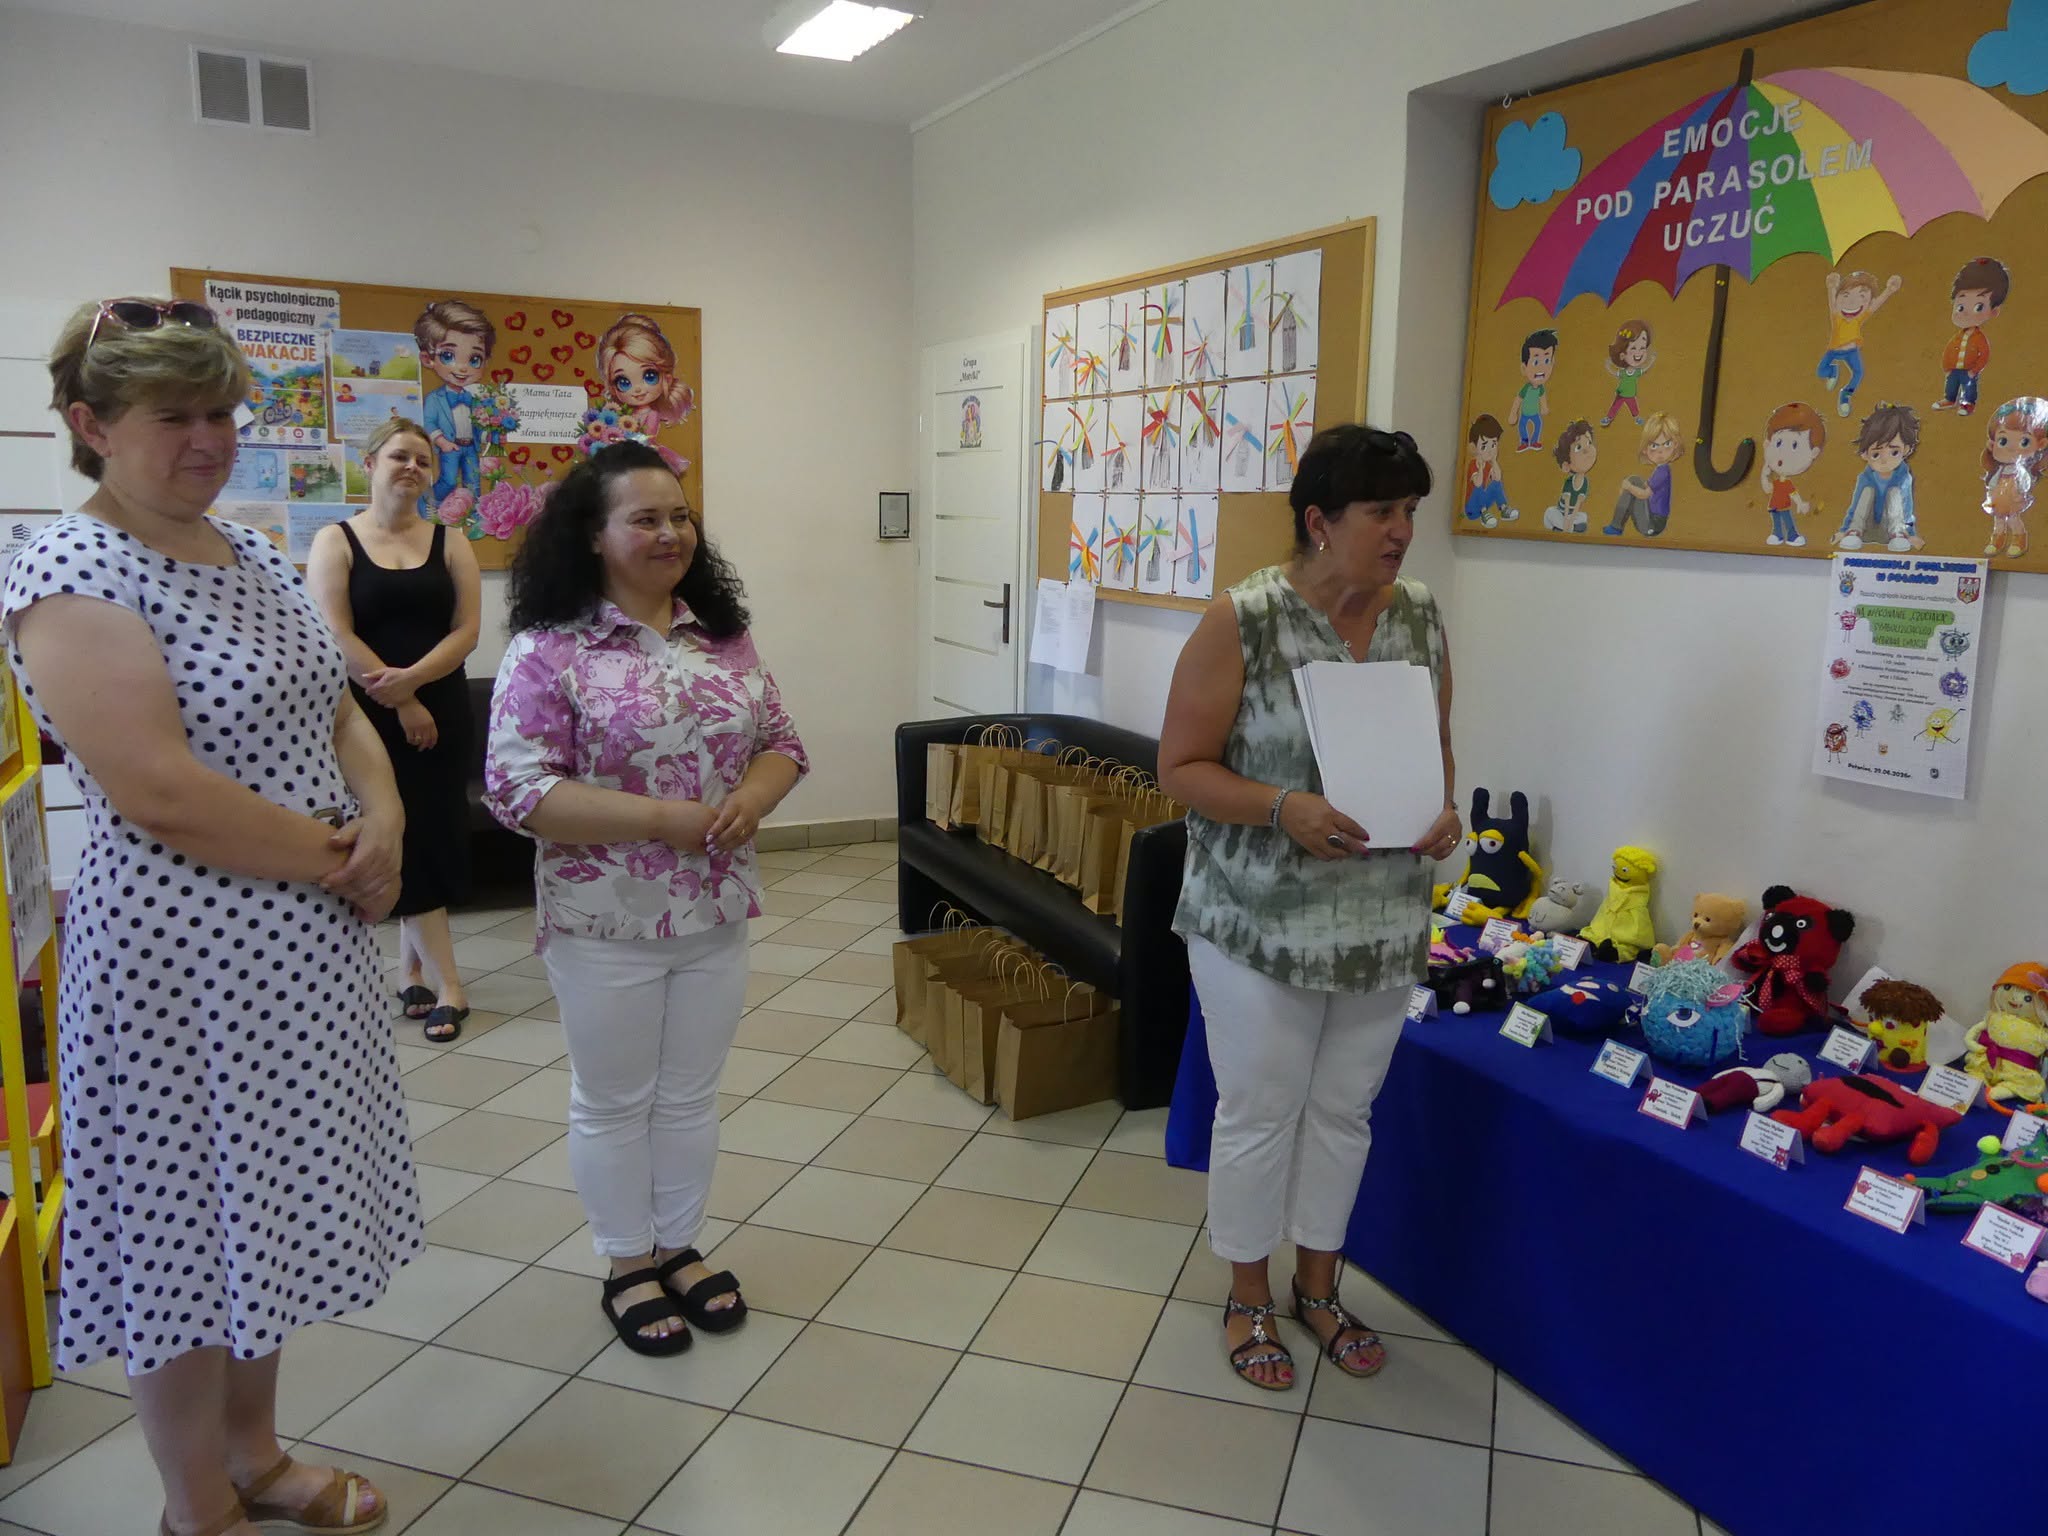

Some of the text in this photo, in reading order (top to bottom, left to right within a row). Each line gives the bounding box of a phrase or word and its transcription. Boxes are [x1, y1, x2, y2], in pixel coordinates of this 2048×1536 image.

[1662, 98, 1804, 159] EMOCJE
[1576, 138, 1873, 226] POD PARASOLEM
[1663, 192, 1776, 252] UCZUĆ
[209, 285, 339, 308] Kącik psychologiczno-
[236, 307, 316, 326] pedagogiczny
[237, 328, 316, 346] BEZPIECZNE
[239, 342, 316, 362] WAKACJE
[523, 388, 572, 398] Mama Tata
[519, 408, 577, 419] najpiękniejsze
[520, 428, 576, 438] słowa świata
